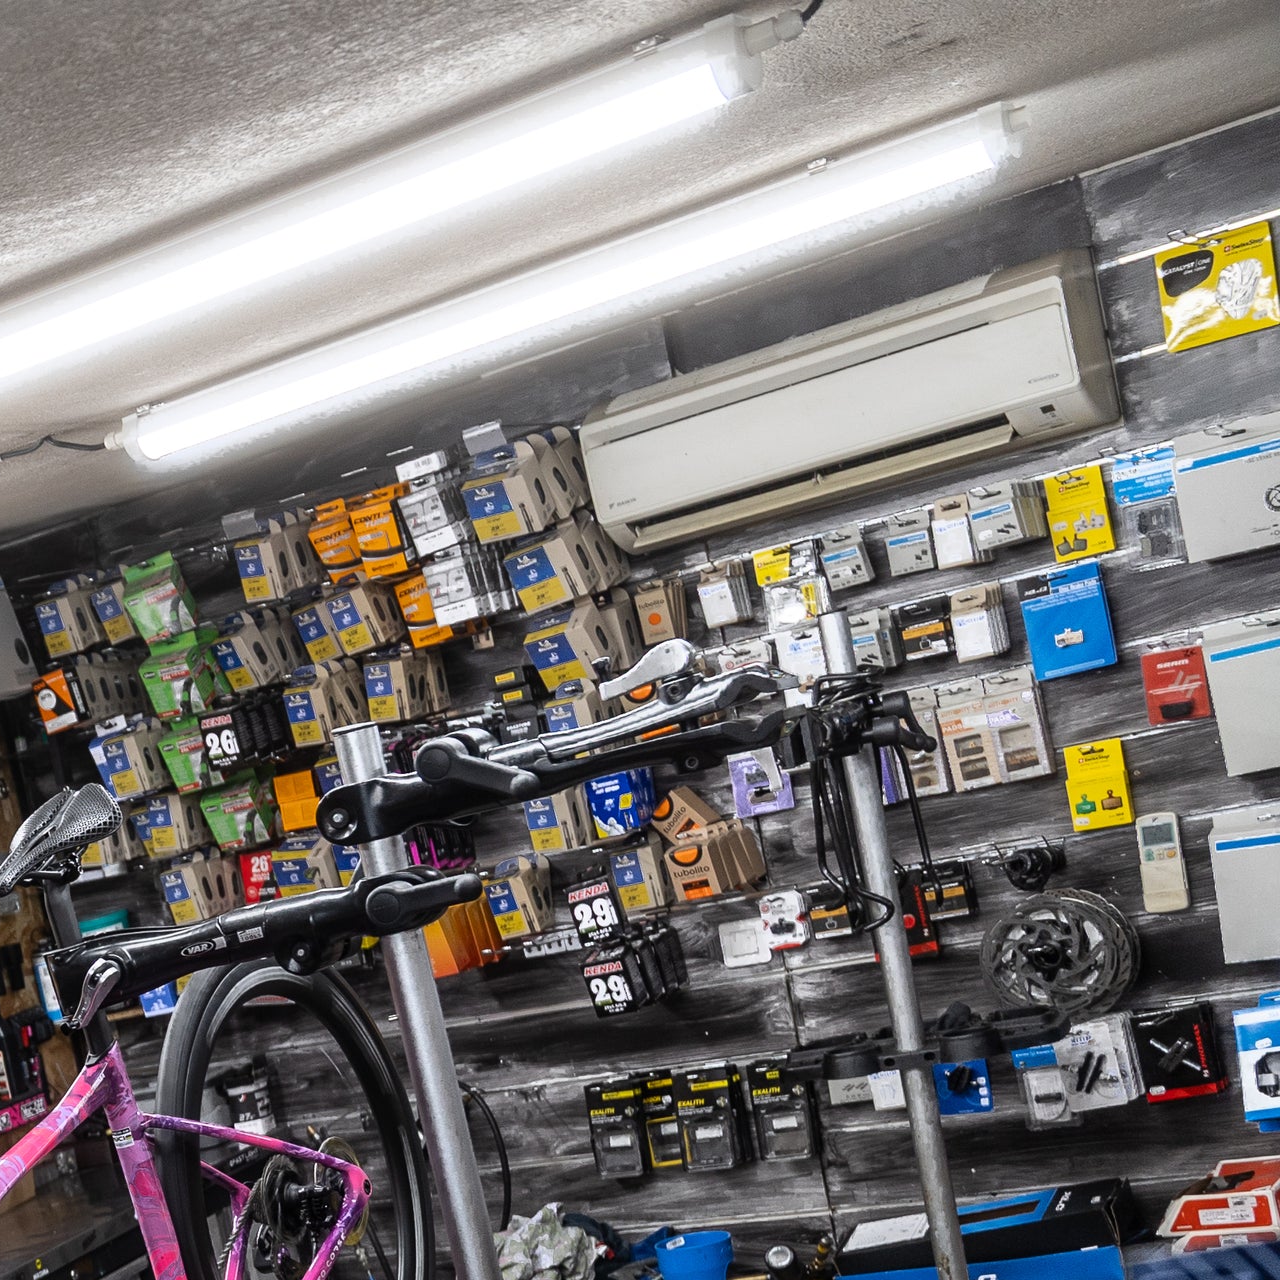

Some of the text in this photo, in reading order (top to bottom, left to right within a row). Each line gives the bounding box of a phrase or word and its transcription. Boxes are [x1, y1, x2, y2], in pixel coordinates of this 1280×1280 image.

[354, 513, 381, 526] CONTI
[1157, 658, 1189, 669] SRAM
[201, 714, 232, 729] KENDA
[663, 806, 687, 834] tubolito
[673, 864, 711, 879] tubolito
[568, 882, 609, 903] KENDA
[574, 898, 613, 931] 29
[187, 943, 209, 955] VAR
[584, 960, 622, 977] KENDA
[590, 974, 628, 1004] 29
[753, 1086, 781, 1096] EXALITH
[677, 1098, 705, 1108] EXALITH
[590, 1107, 616, 1116] EXALITH
